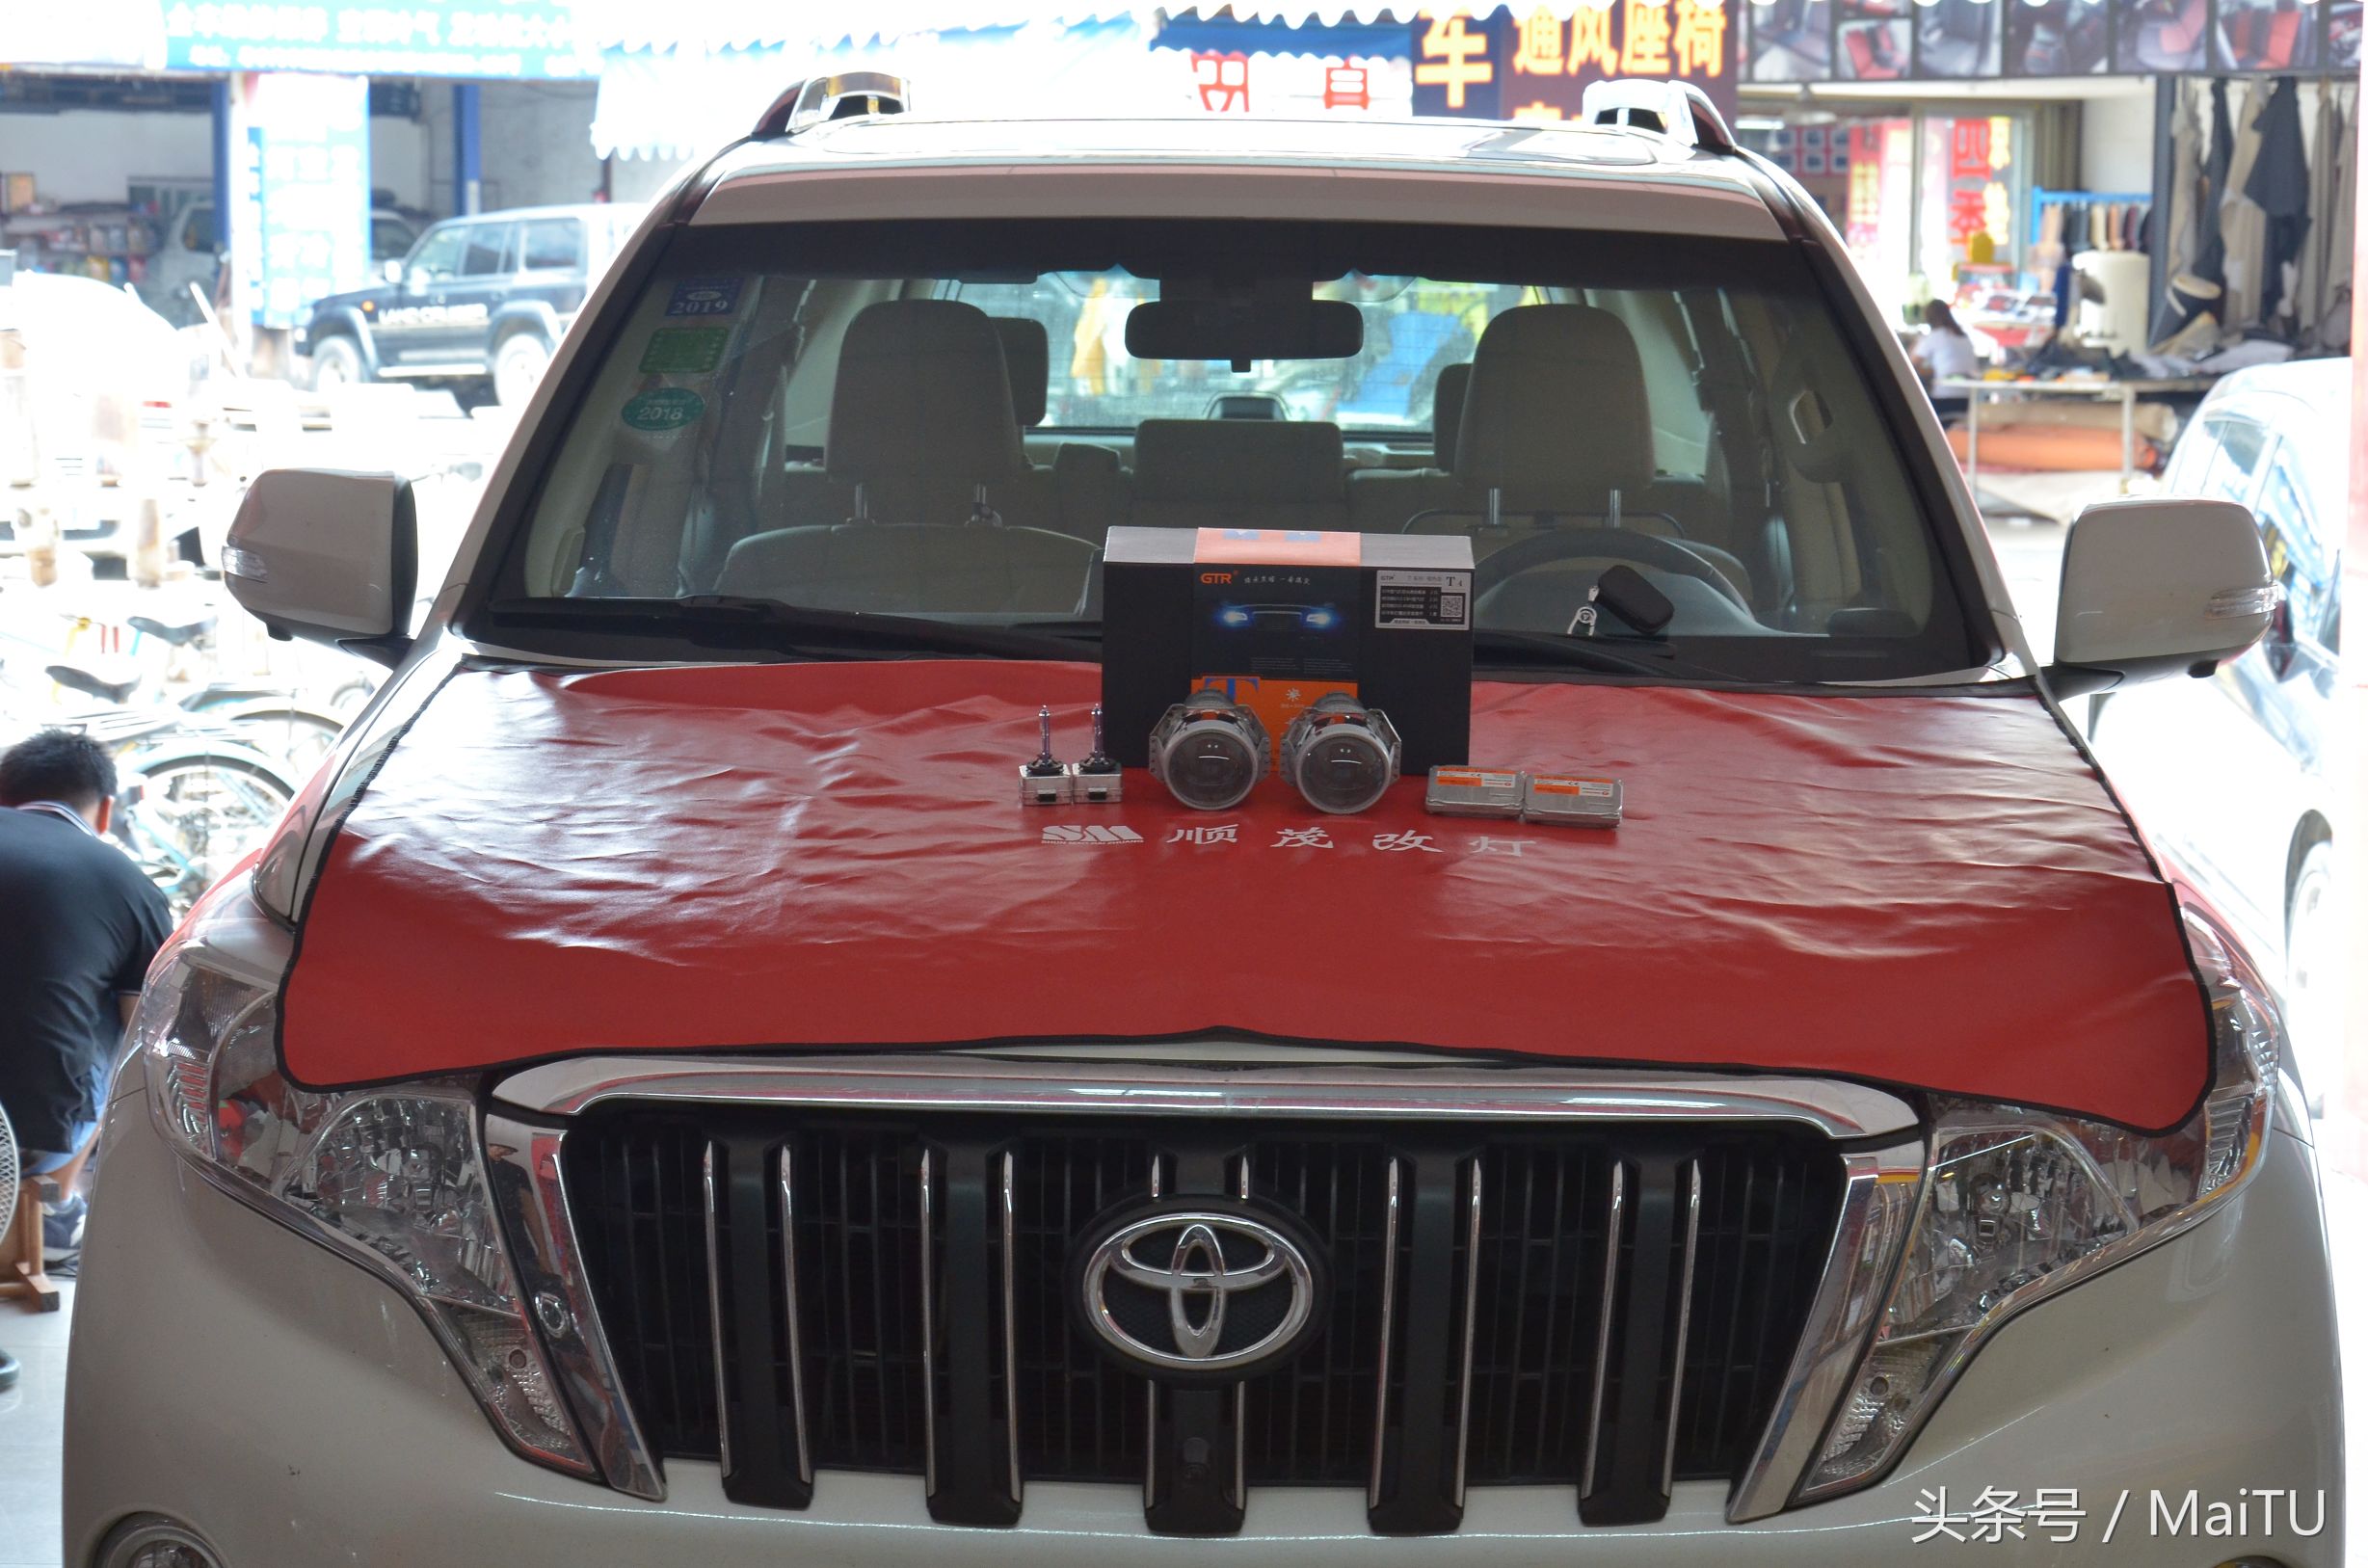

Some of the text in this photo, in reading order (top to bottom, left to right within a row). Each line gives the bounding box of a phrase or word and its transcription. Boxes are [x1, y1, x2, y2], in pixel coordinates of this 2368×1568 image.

[1512, 0, 1727, 78] 通风座椅
[1414, 4, 1493, 109] 车
[671, 299, 729, 314] 2019
[1199, 571, 1232, 585] GTR
[1166, 823, 1536, 857] 顺茂改灯
